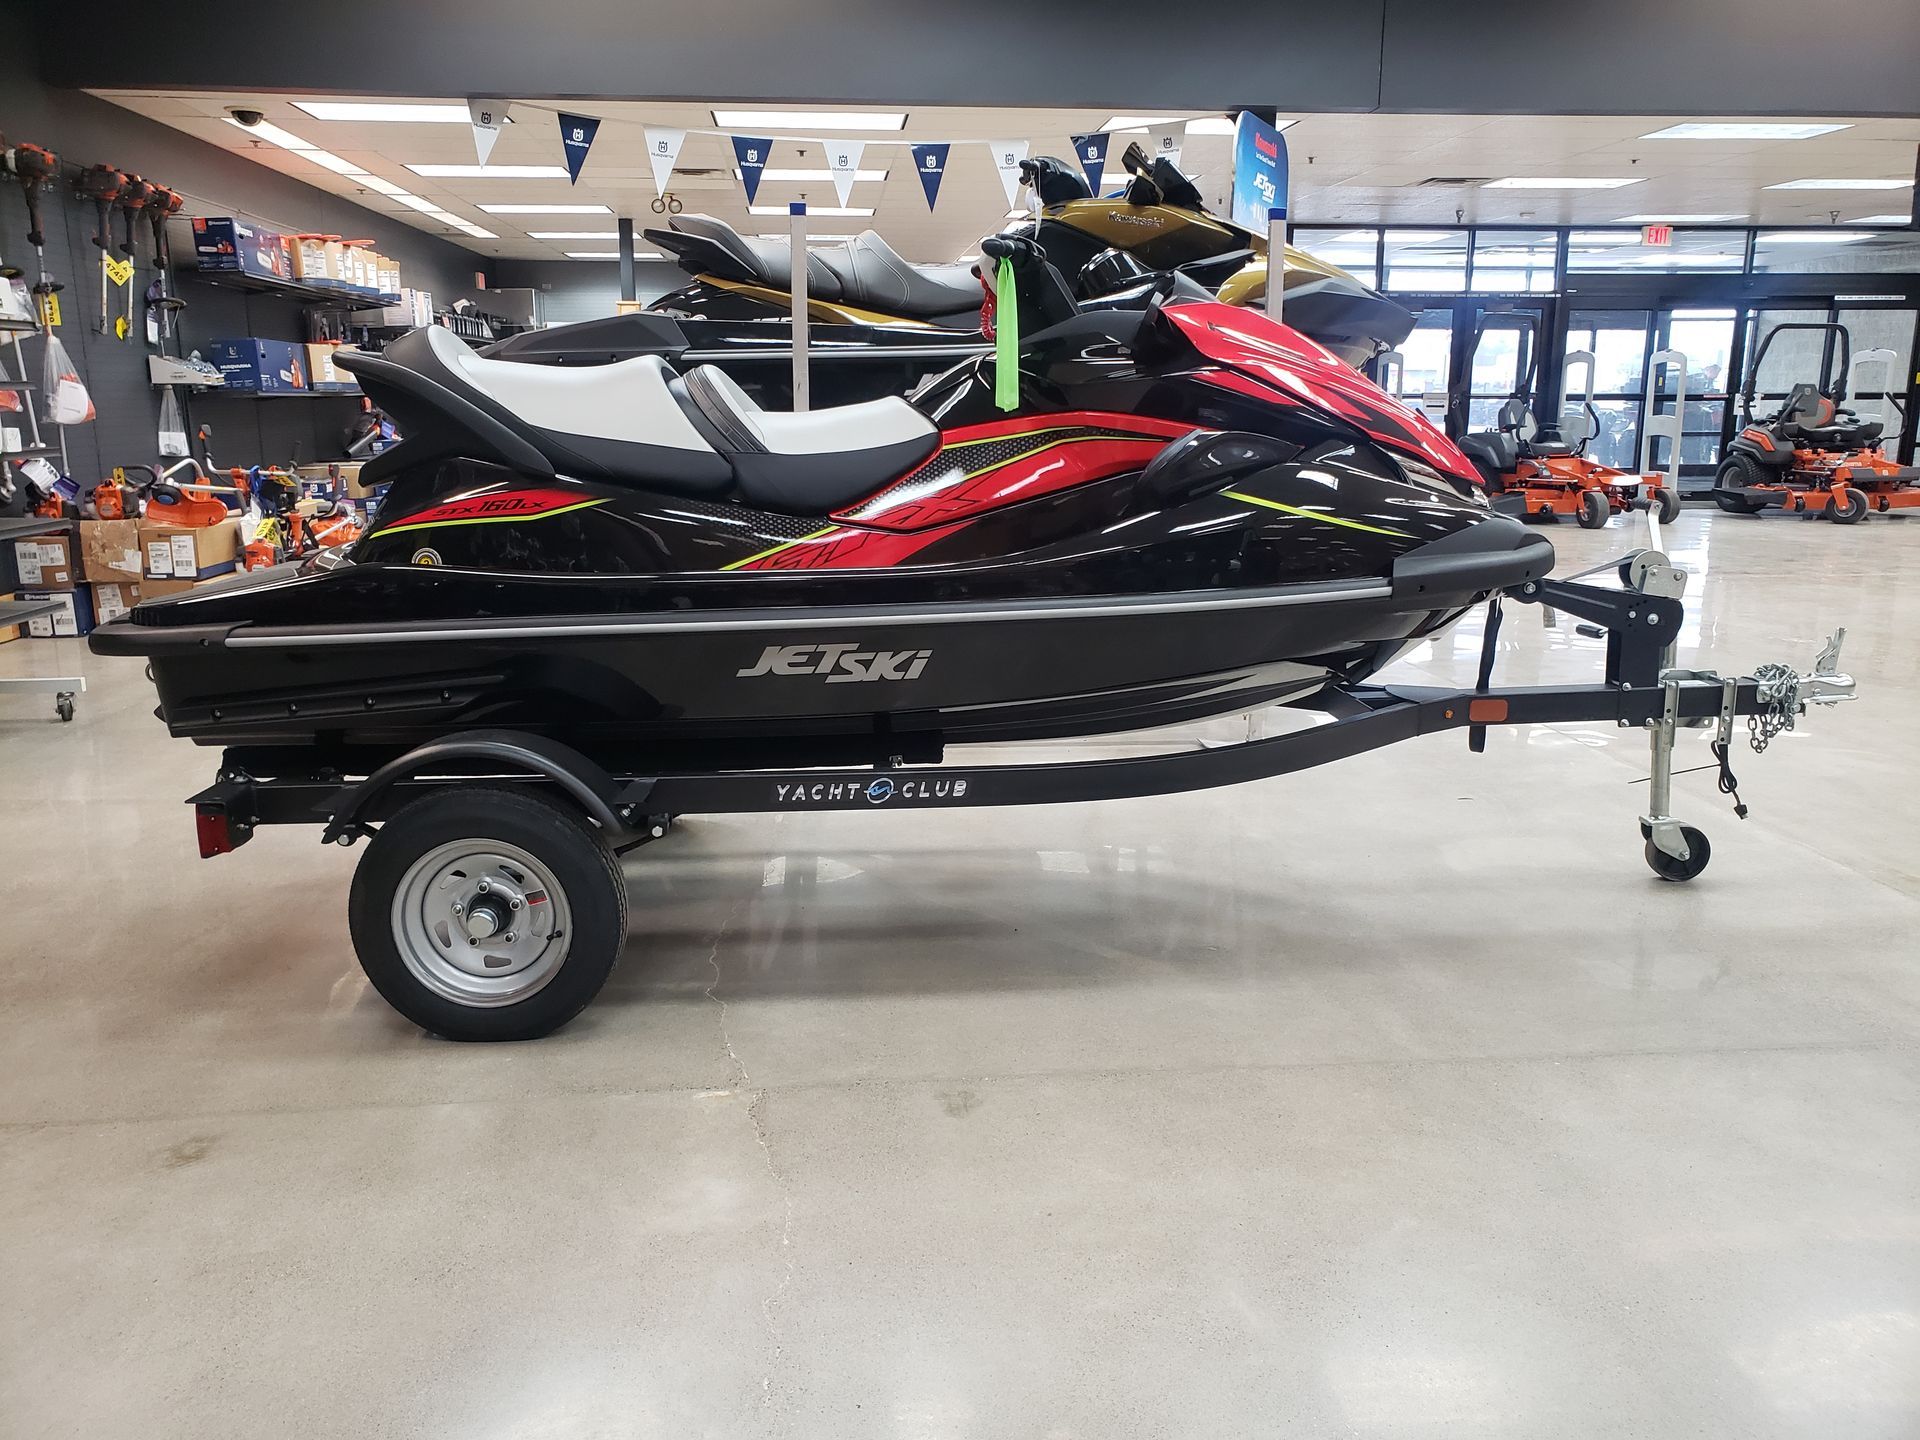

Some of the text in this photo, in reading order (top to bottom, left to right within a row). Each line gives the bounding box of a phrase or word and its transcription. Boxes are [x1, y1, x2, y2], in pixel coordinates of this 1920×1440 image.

[565, 139, 589, 148] Husqvarna
[741, 160, 764, 168] Husqvarna
[1082, 157, 1104, 165] Husqvarna
[1108, 210, 1165, 228] Kawasaki
[1647, 226, 1669, 244] EXIT
[776, 779, 968, 802] YACHT CLUB
